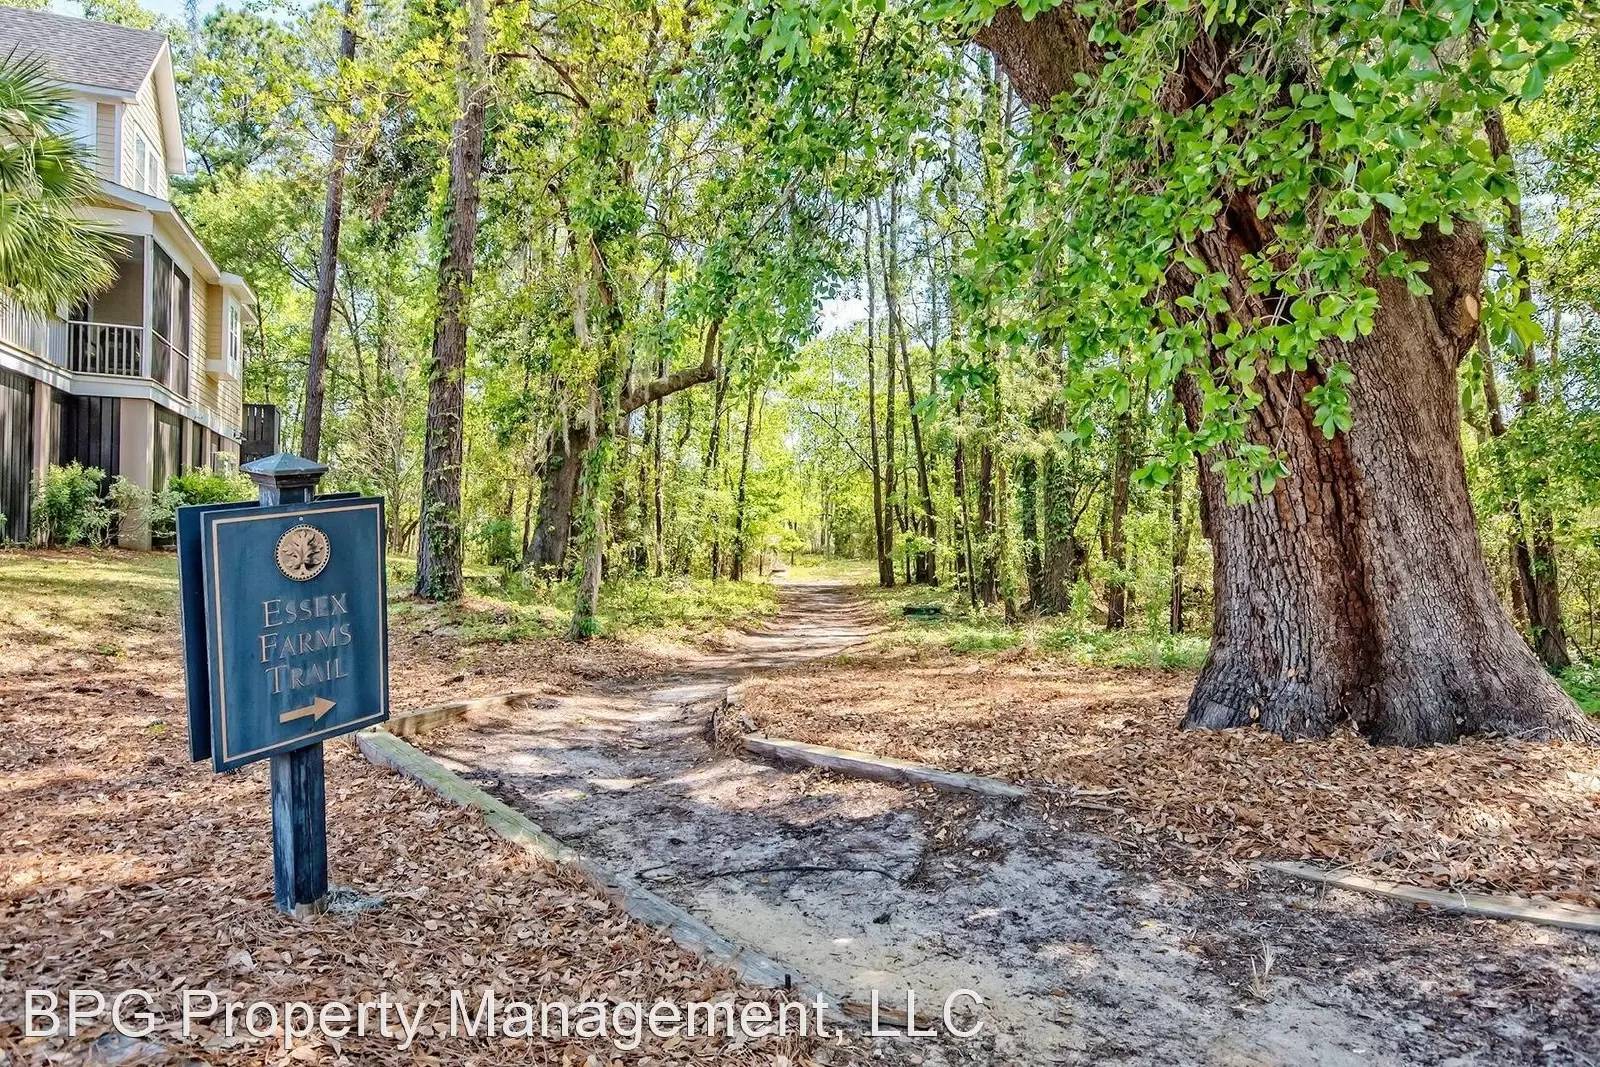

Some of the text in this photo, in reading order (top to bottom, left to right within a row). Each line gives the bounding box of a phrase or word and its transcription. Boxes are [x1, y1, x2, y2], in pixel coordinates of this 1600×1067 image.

[262, 593, 348, 628] ESSEX
[258, 624, 352, 664] FARMS
[265, 657, 349, 694] TRAIL
